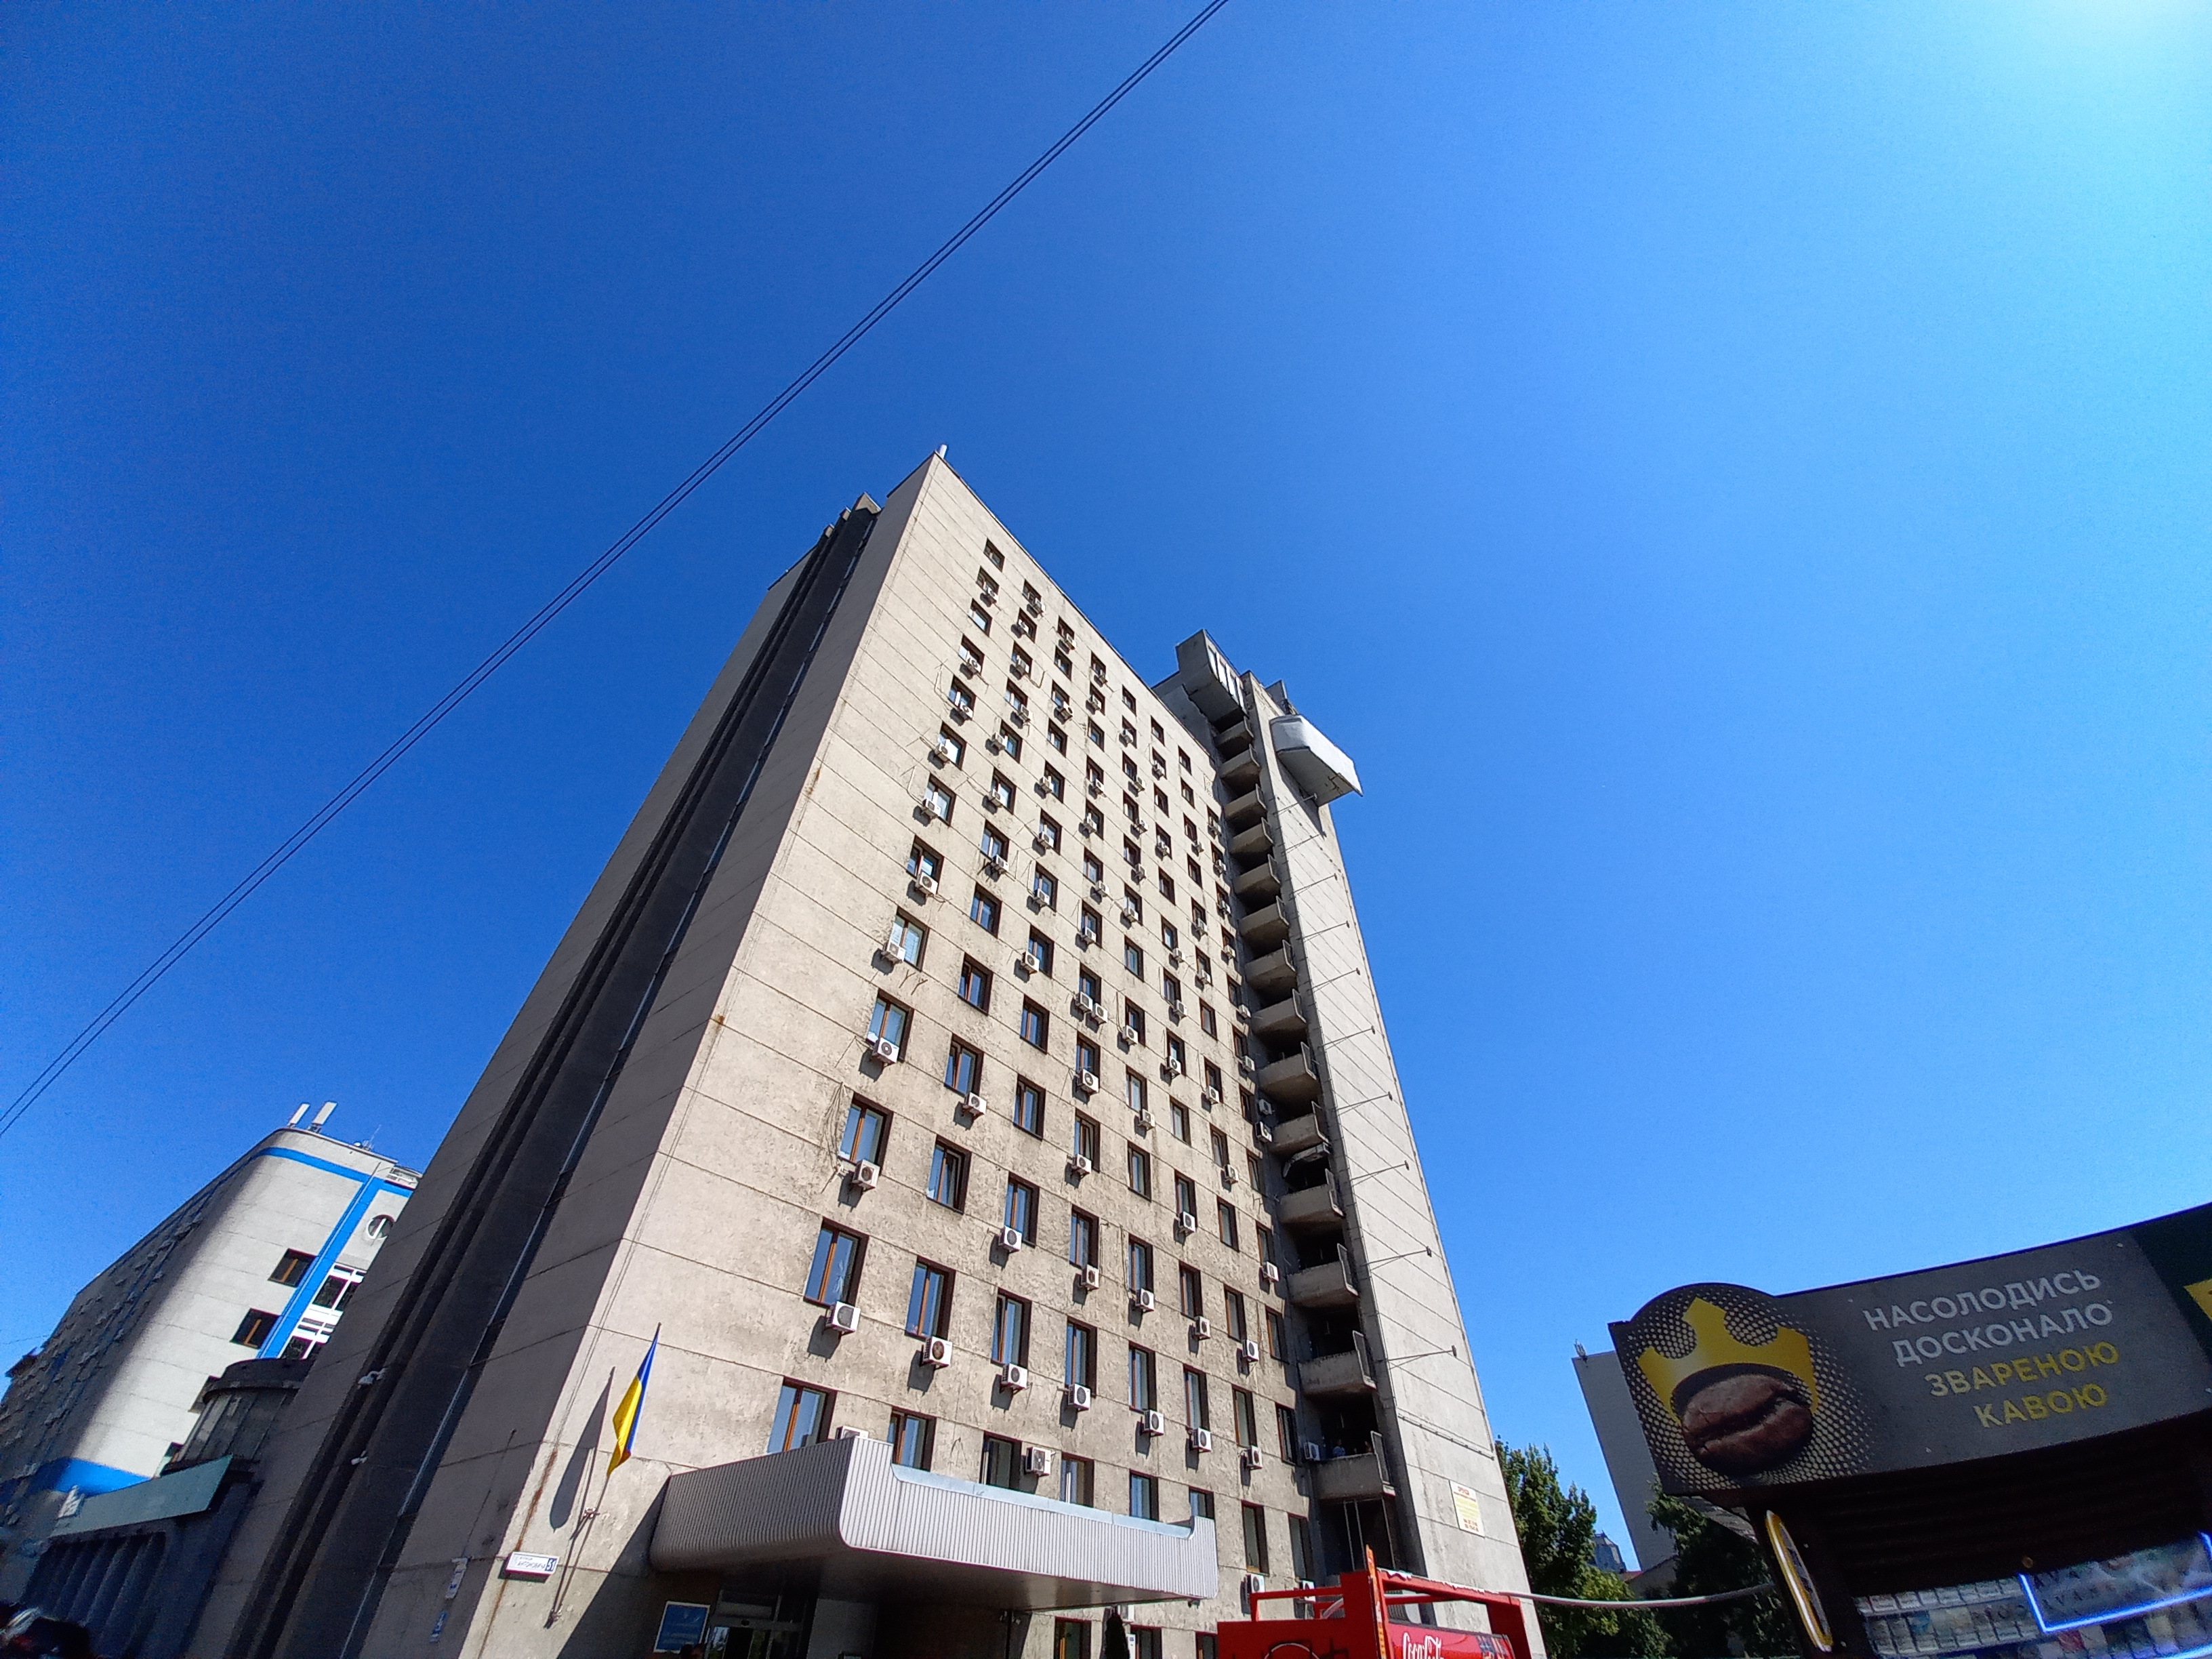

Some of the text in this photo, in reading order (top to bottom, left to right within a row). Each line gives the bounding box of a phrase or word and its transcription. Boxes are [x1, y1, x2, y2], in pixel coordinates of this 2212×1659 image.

[1862, 1269, 2102, 1331] НАСОЛОДИСЬ
[1892, 1303, 2113, 1368] ДОСКОНАЛО
[1924, 1341, 2120, 1397] ЗВАРЕНОЮ
[1973, 1382, 2108, 1428] КАВОЮ
[546, 1559, 556, 1571] 51
